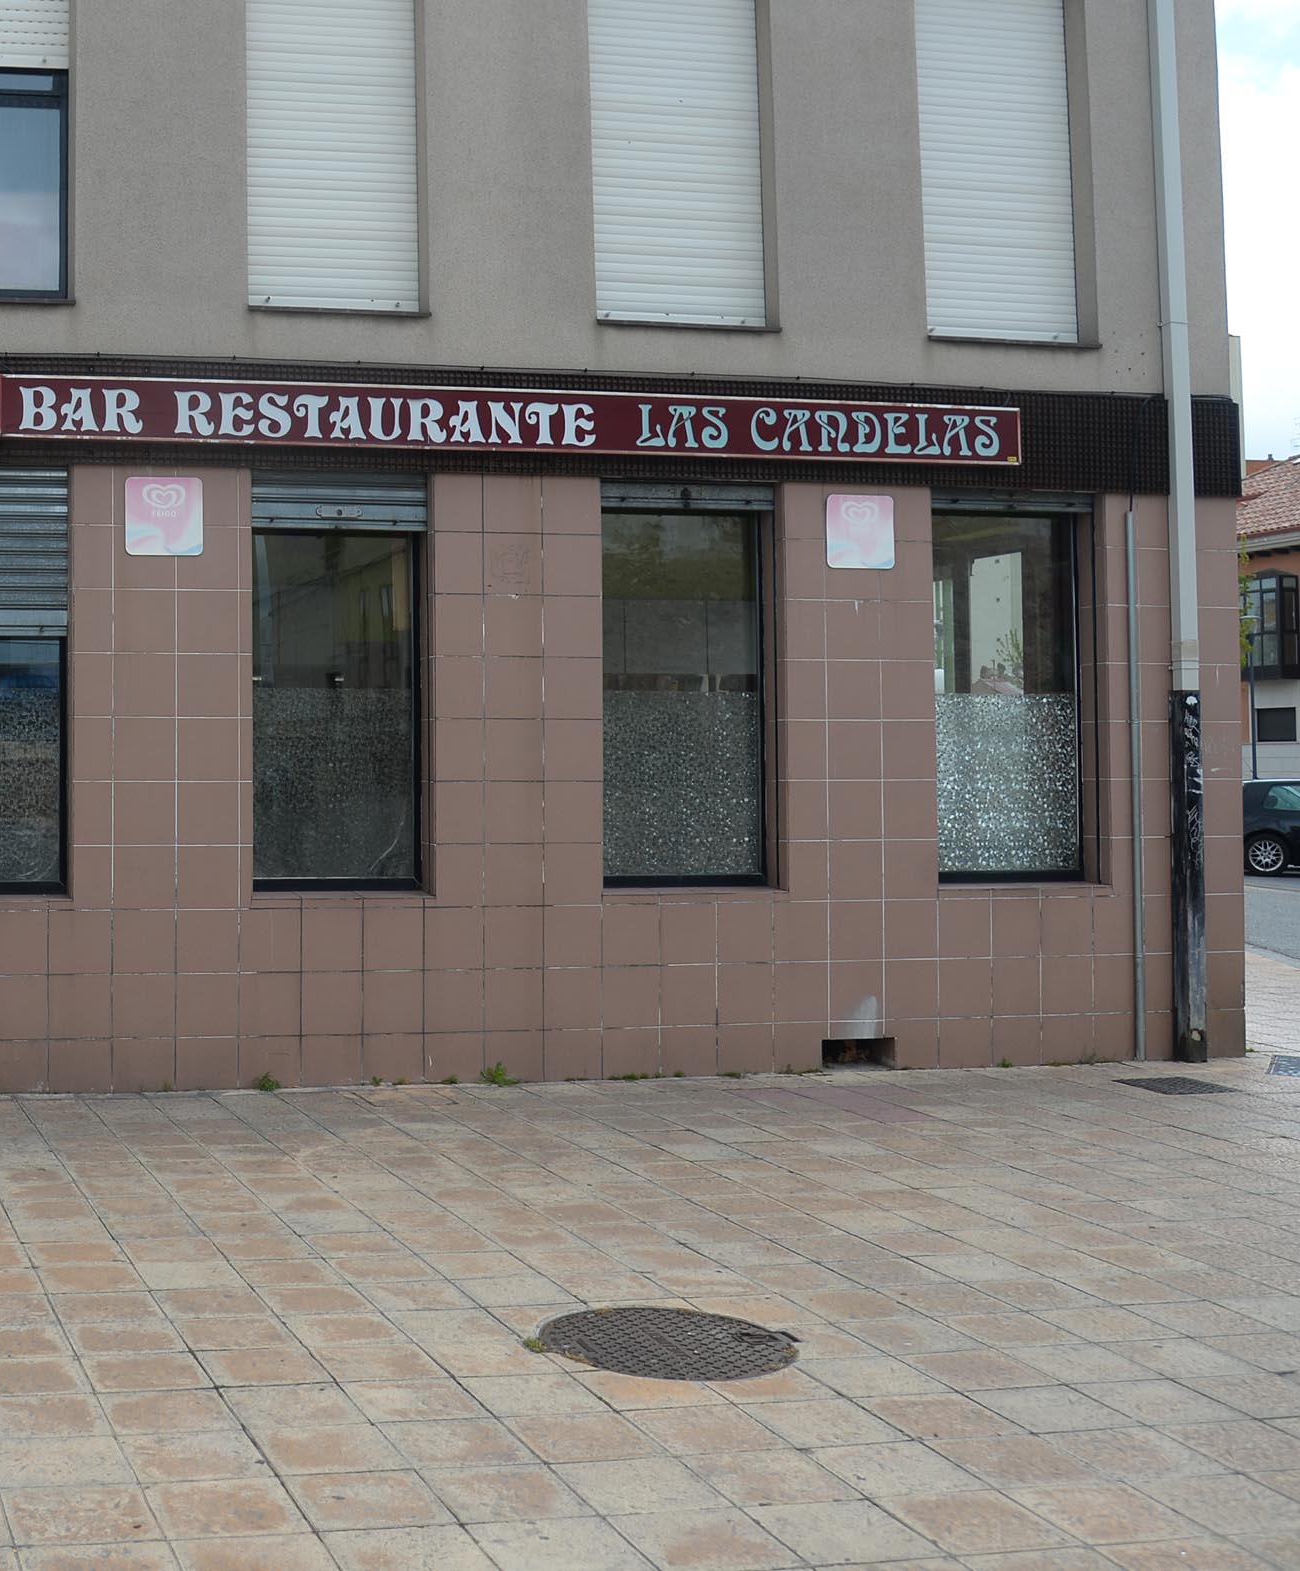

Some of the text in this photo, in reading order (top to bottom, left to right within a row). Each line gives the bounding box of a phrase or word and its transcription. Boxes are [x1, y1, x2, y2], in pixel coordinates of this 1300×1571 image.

[19, 386, 596, 447] BAR RESTAURANTE
[636, 404, 1000, 456] LAS CANDELAS
